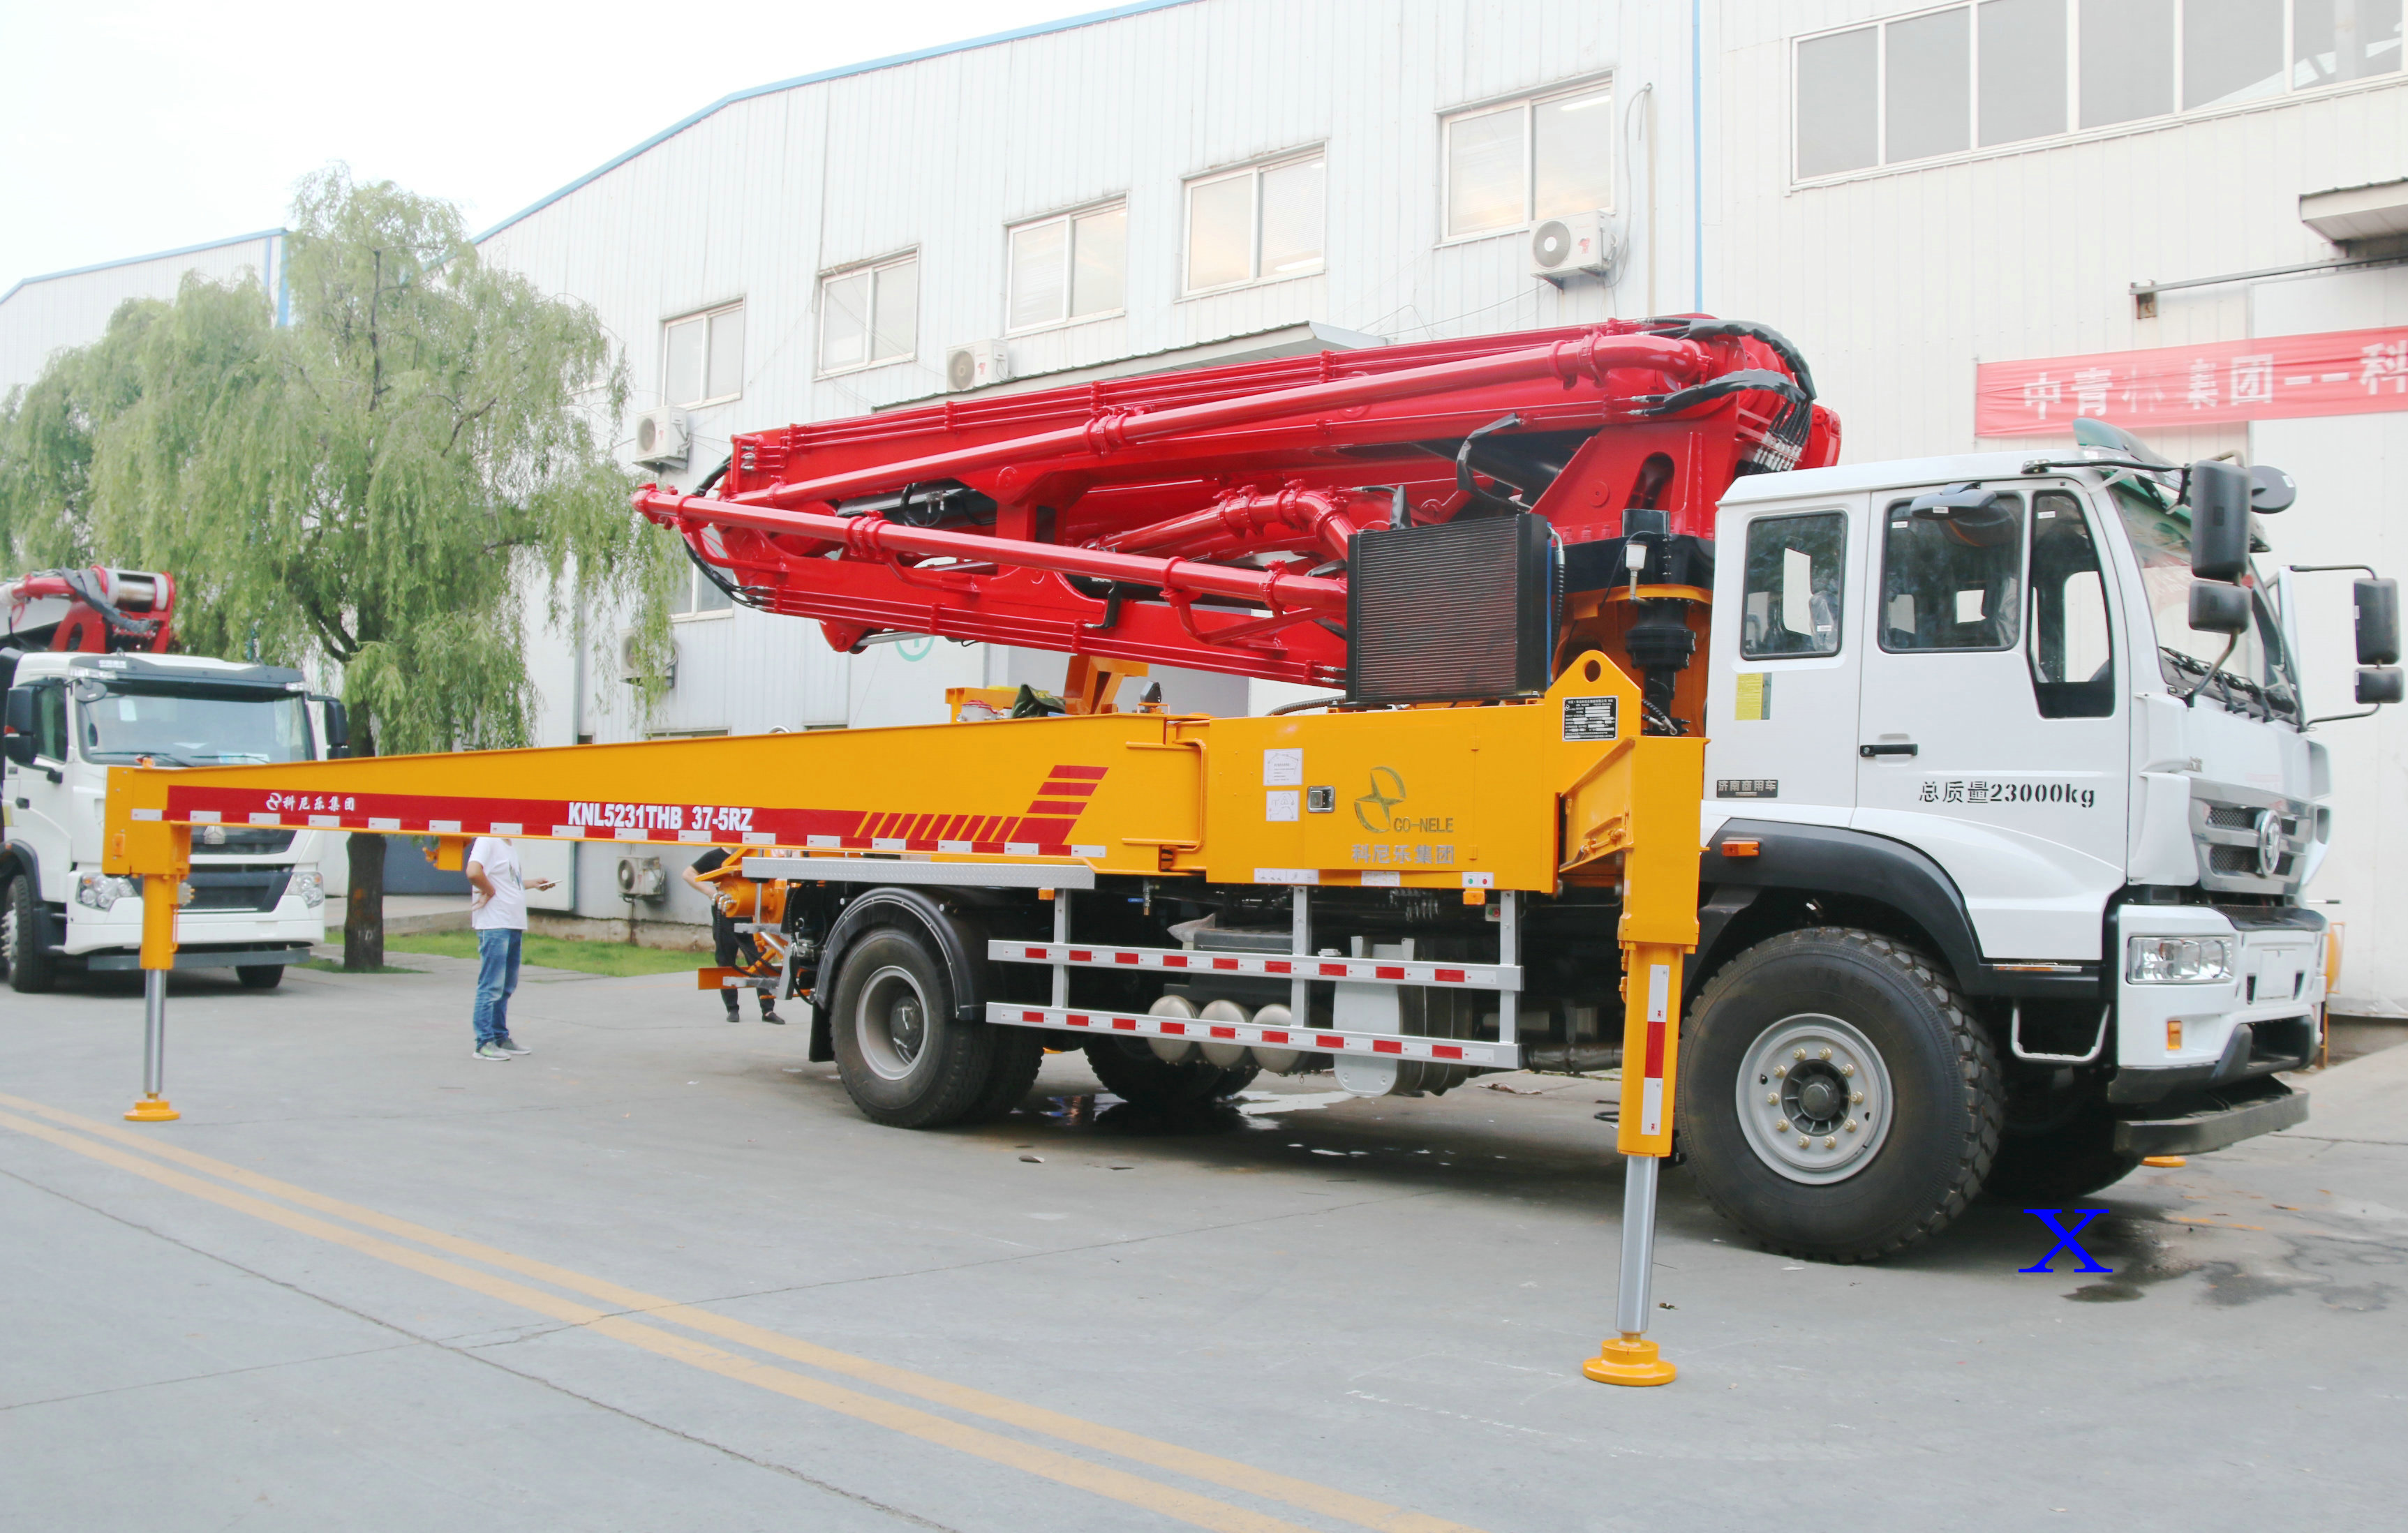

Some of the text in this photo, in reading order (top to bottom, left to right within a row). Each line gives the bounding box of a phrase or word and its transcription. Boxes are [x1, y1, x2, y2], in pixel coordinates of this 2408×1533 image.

[1718, 779, 1777, 792] 济南商用车
[1919, 780, 2095, 808] 总质量23000kg
[283, 795, 355, 812] 科尼乐集团
[567, 802, 753, 832] KNL5231THB 37-5RZ
[1393, 817, 1454, 832] CO-NELE
[1351, 843, 1455, 865] 科尼乐集团
